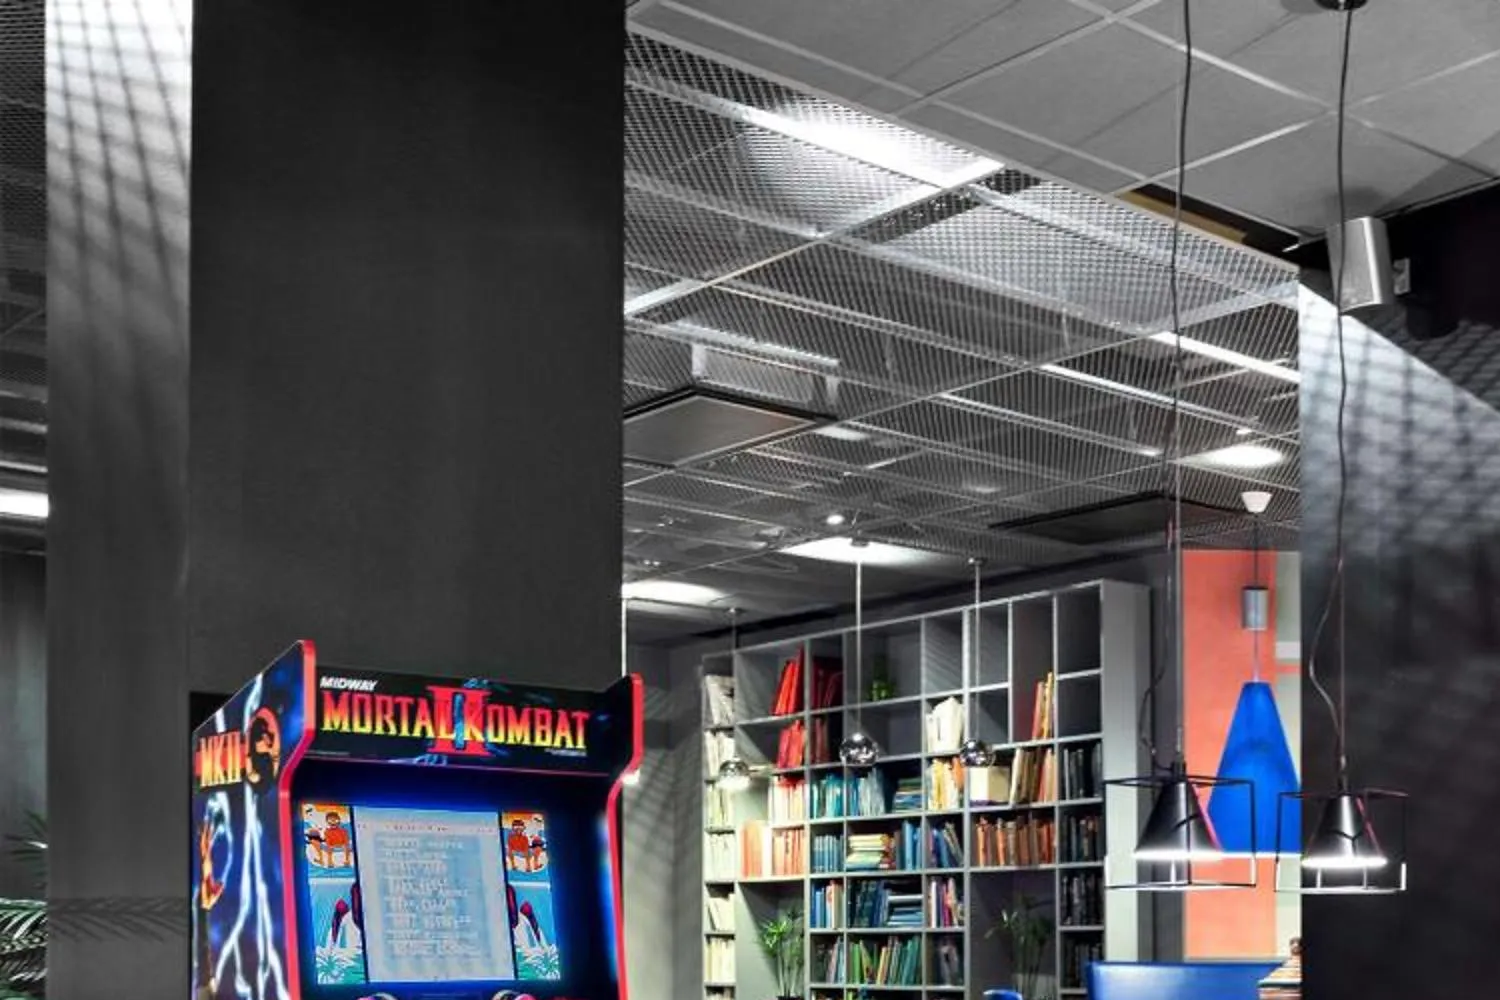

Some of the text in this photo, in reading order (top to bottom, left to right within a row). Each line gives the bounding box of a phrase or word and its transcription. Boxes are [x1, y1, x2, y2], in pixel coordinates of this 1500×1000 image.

[320, 676, 379, 692] MIDWAY
[321, 690, 591, 749] MORTAL KOMBAT
[200, 731, 242, 787] MKII
